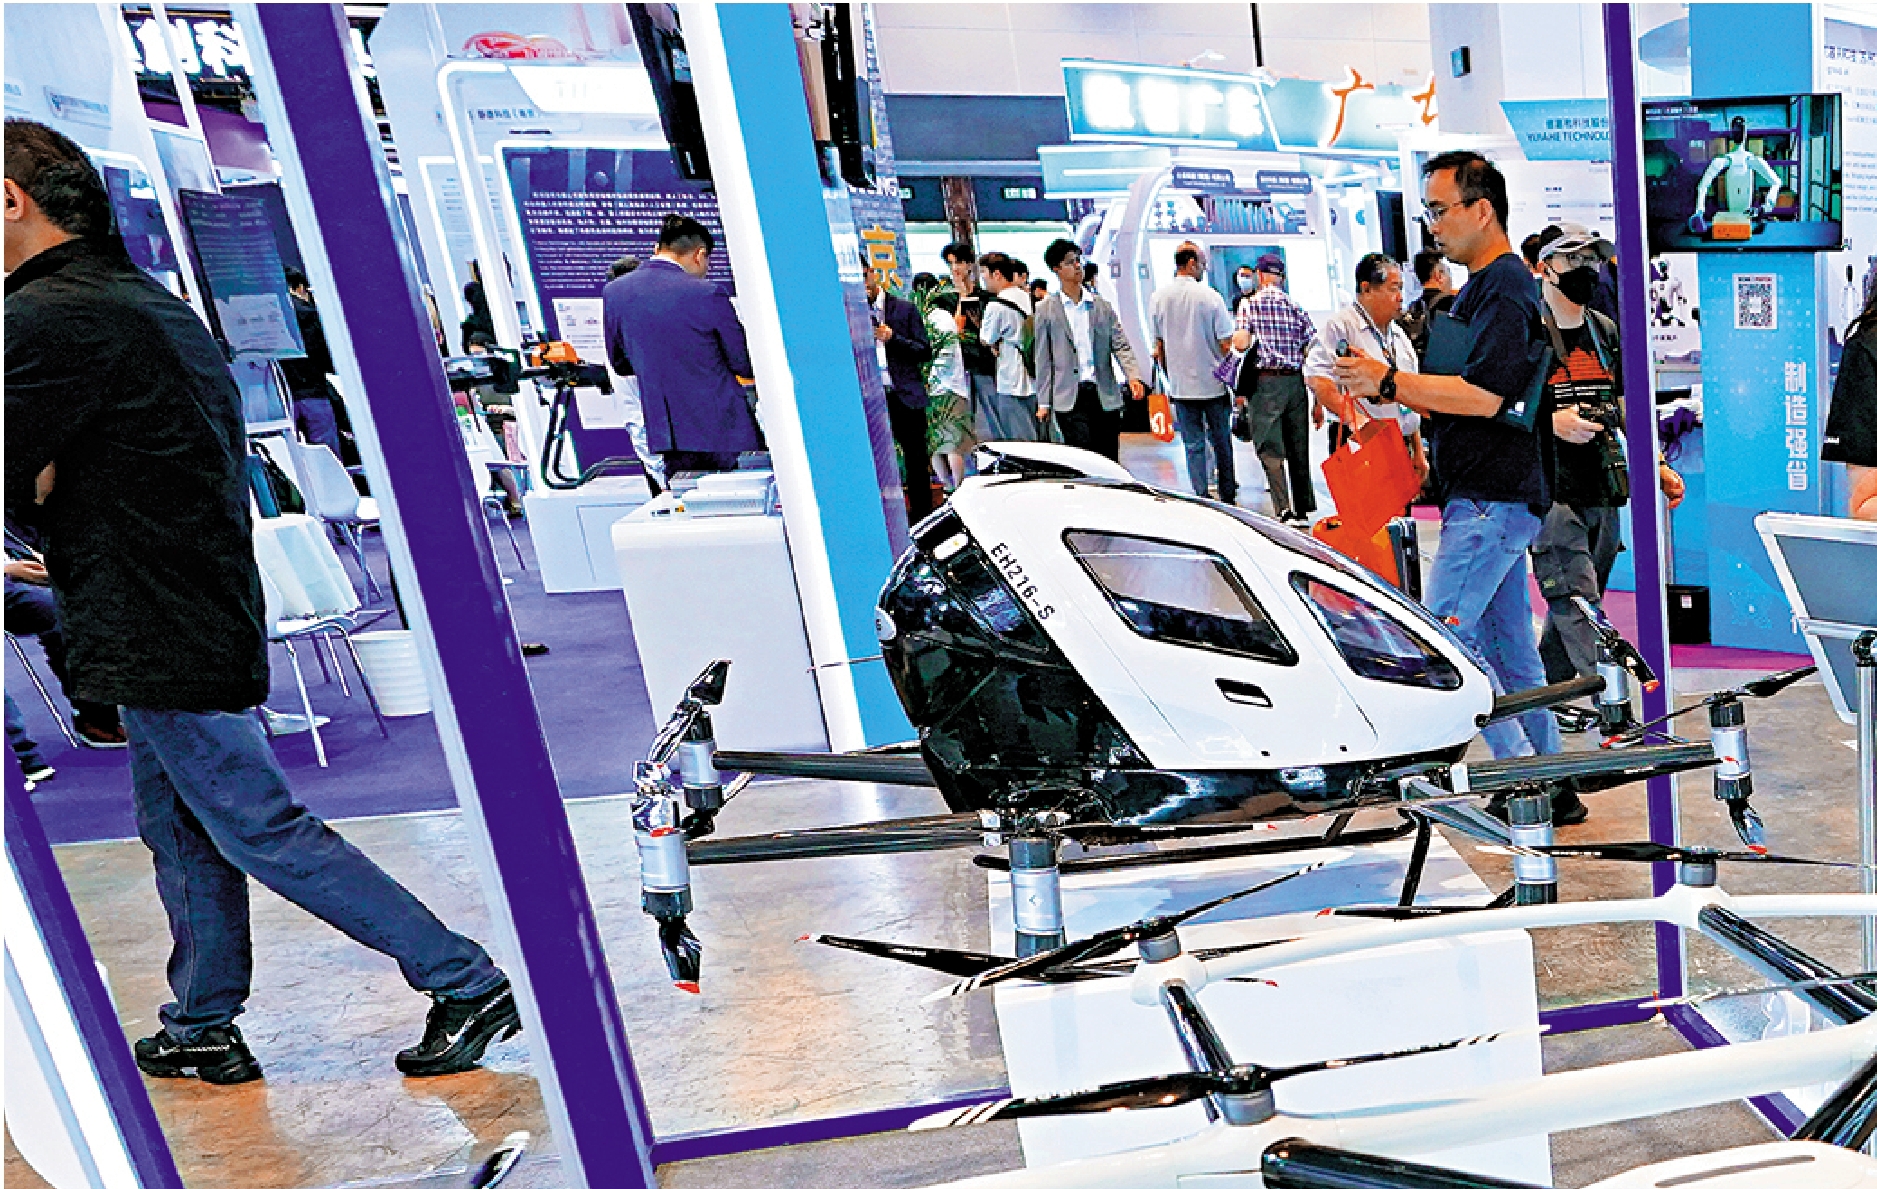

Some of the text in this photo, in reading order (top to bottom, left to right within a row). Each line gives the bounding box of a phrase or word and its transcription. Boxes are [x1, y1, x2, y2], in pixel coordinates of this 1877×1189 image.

[1784, 361, 1808, 491] 制造强省
[990, 542, 1056, 620] EH216-S
